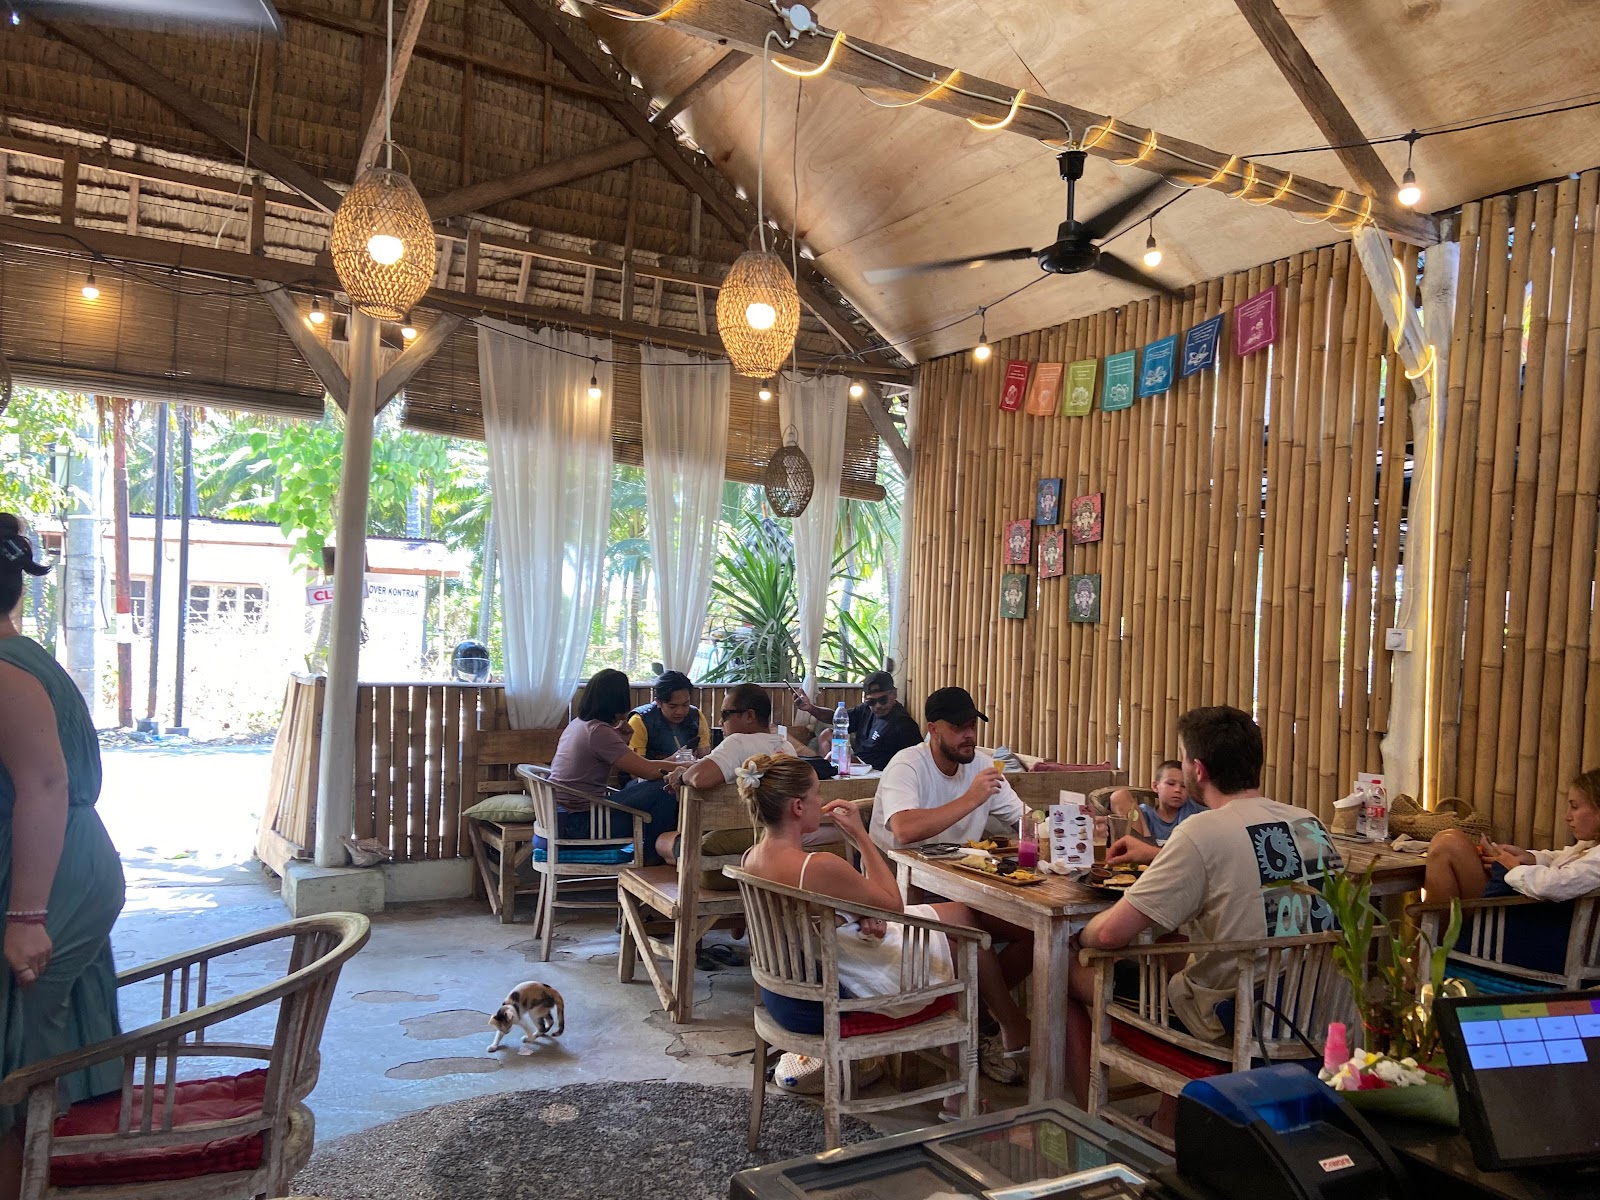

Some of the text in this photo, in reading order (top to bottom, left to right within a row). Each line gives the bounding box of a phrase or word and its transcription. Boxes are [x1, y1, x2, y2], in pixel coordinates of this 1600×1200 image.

[314, 590, 333, 601] CL
[369, 585, 419, 598] OVER KONTRAK
